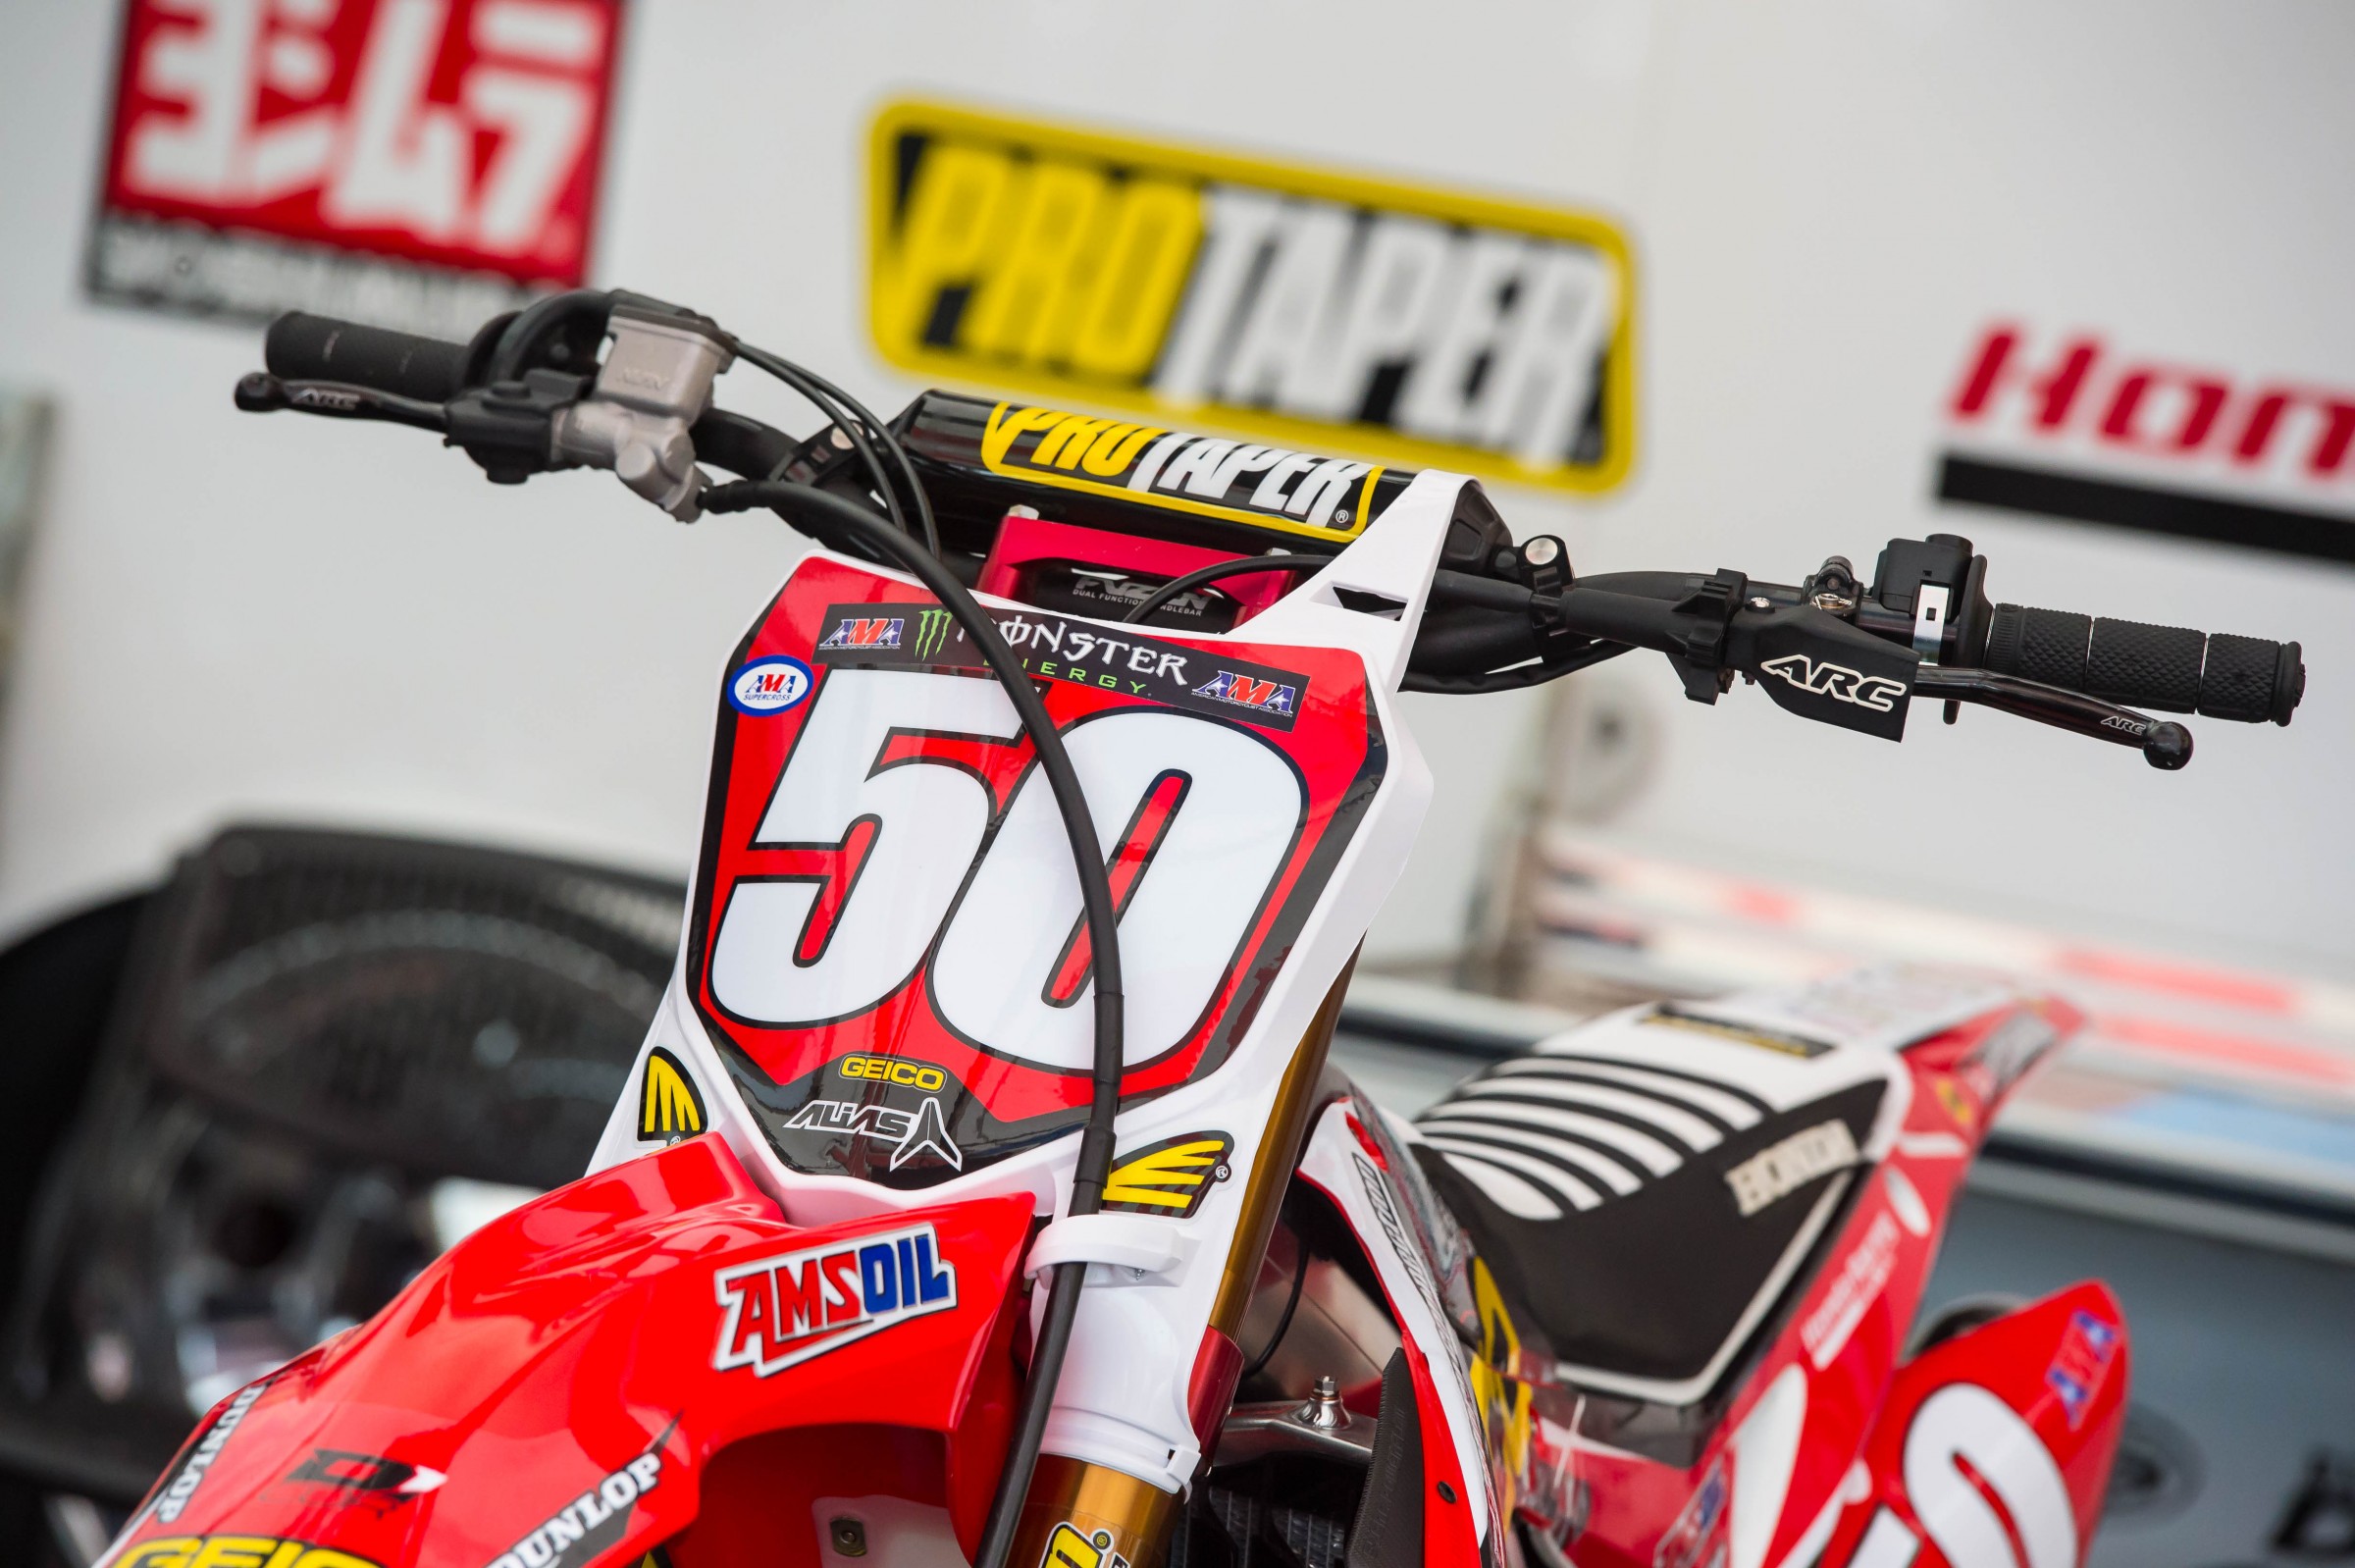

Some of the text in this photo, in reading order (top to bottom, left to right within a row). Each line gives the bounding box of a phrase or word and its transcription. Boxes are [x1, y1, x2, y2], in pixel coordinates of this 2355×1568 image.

[1072, 588, 1096, 600] DUAL
[1159, 603, 1203, 617] NDLEBAR
[818, 618, 905, 646] AMA
[745, 673, 797, 693] AMA
[982, 657, 1147, 695] ERGY
[1191, 669, 1296, 714] AMA
[1760, 653, 1907, 712] ARC
[743, 693, 792, 702] SUPERCROSS
[2100, 715, 2147, 736] ARC
[708, 667, 1309, 1073] 50
[840, 1056, 945, 1091] GEICO
[724, 1232, 951, 1367] AMSOIL
[157, 1384, 269, 1524] DUNLOP
